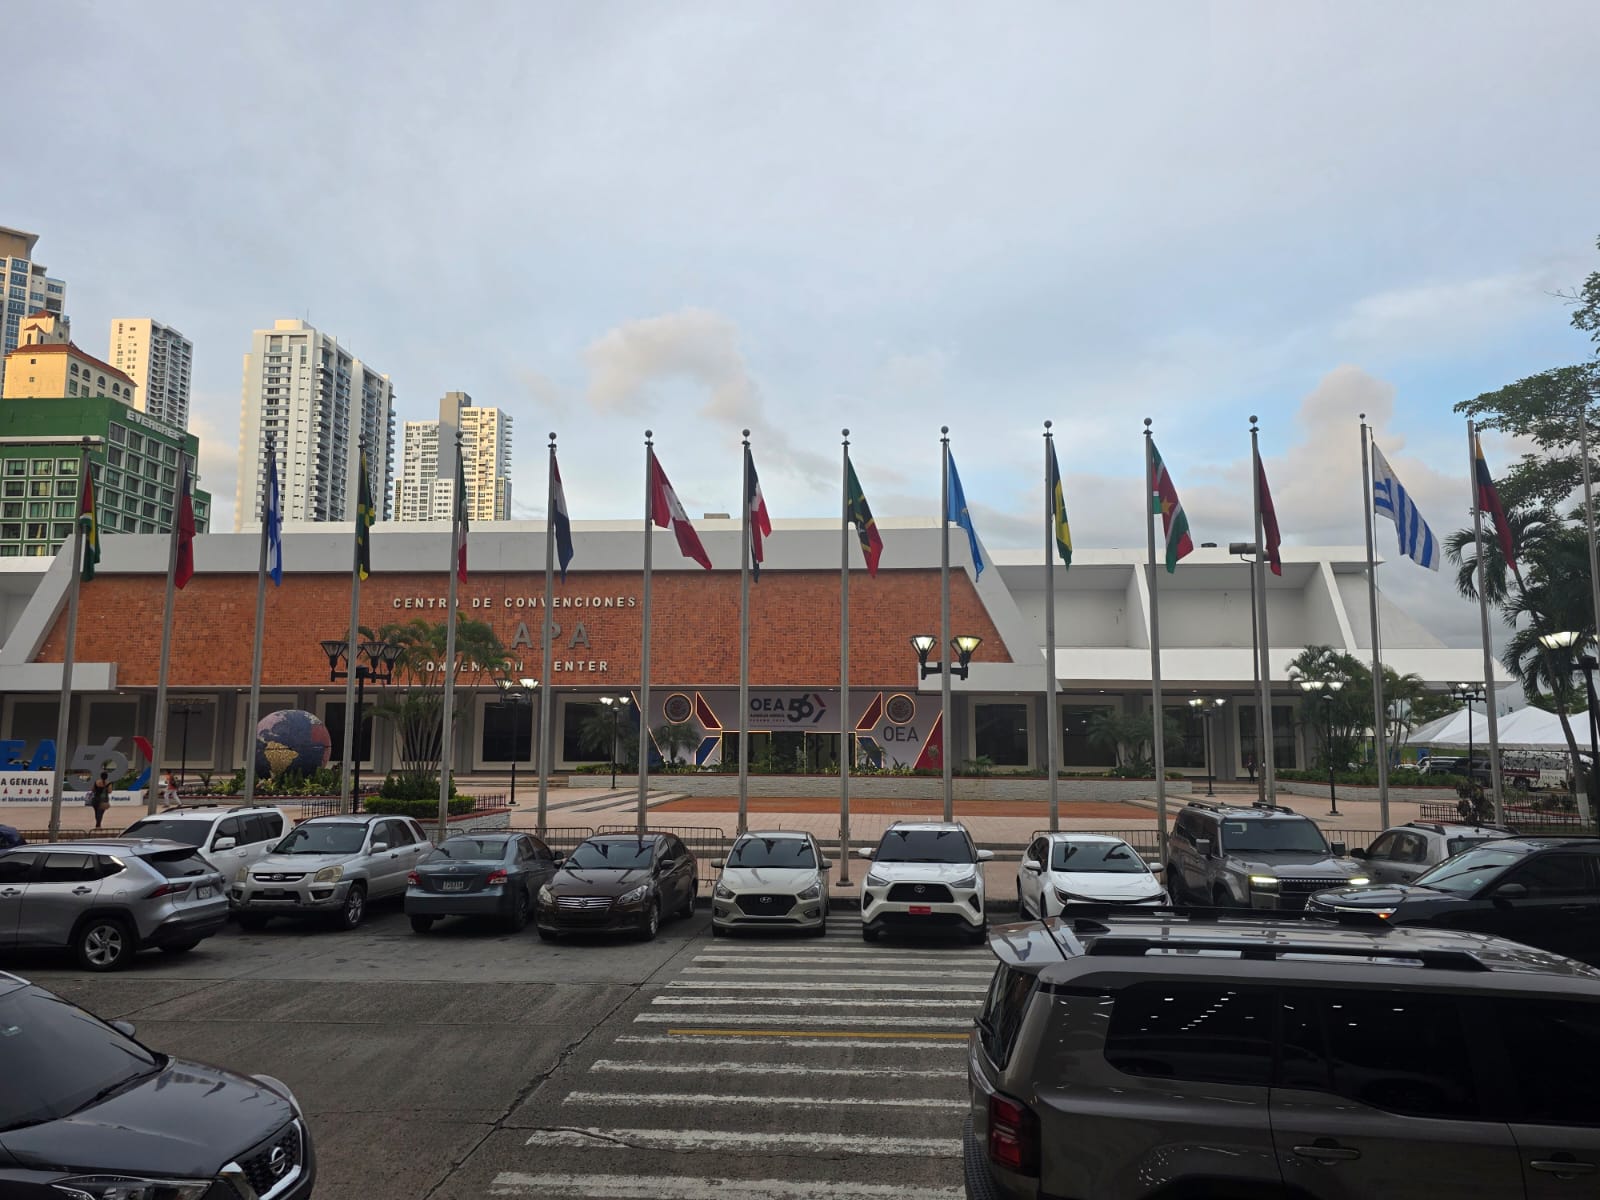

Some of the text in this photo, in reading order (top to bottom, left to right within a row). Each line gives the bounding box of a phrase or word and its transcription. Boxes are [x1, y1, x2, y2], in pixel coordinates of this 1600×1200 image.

[127, 409, 187, 443] EVERGREE
[472, 597, 492, 608] DE
[553, 661, 608, 672] ENTER
[750, 698, 785, 711] OEA
[883, 726, 919, 742] OEA
[10, 778, 49, 786] GENERAL
